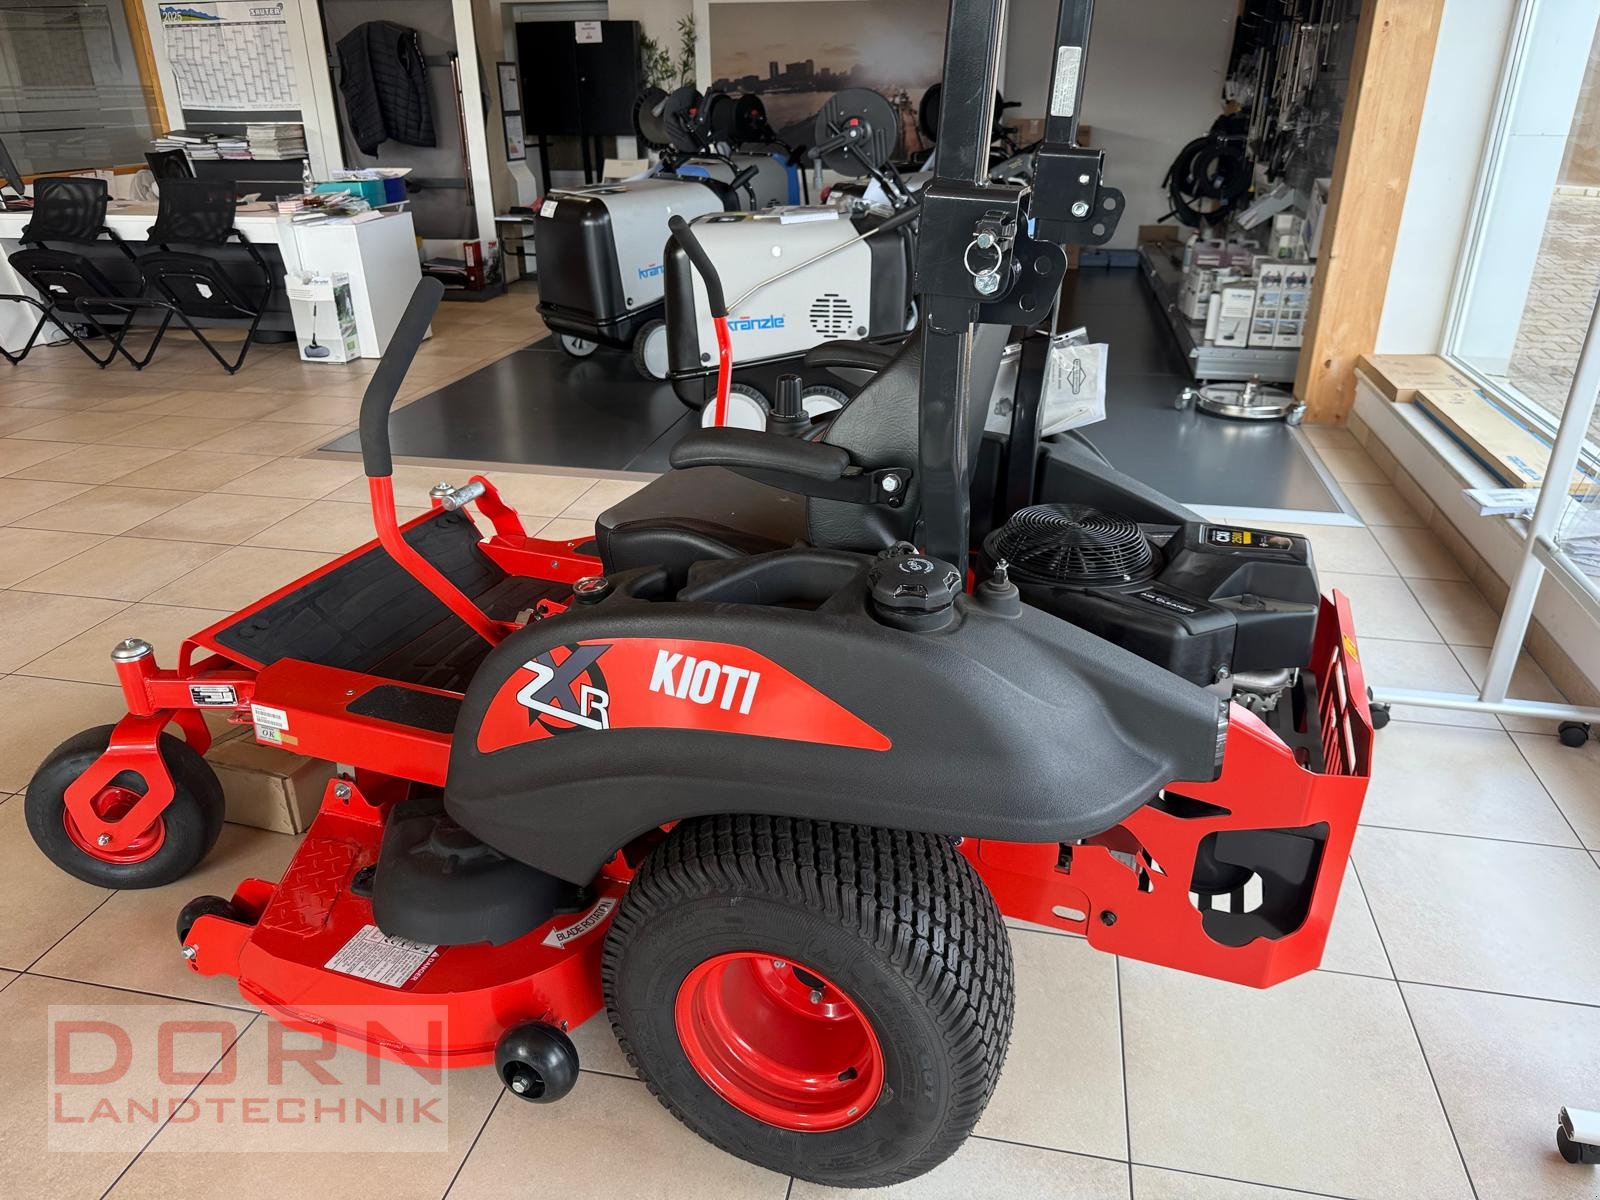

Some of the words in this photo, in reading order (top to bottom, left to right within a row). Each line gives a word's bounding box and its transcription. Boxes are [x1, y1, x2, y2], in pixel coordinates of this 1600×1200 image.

[163, 11, 182, 22] 2025
[249, 8, 281, 16] SAUTER
[638, 263, 665, 280] krän
[1156, 597, 1195, 613] CLEANER
[649, 649, 760, 715] KIOTI
[262, 729, 275, 738] OK
[556, 924, 583, 942] BLADE
[581, 901, 612, 929] ROTATION
[410, 957, 435, 982] DANGER
